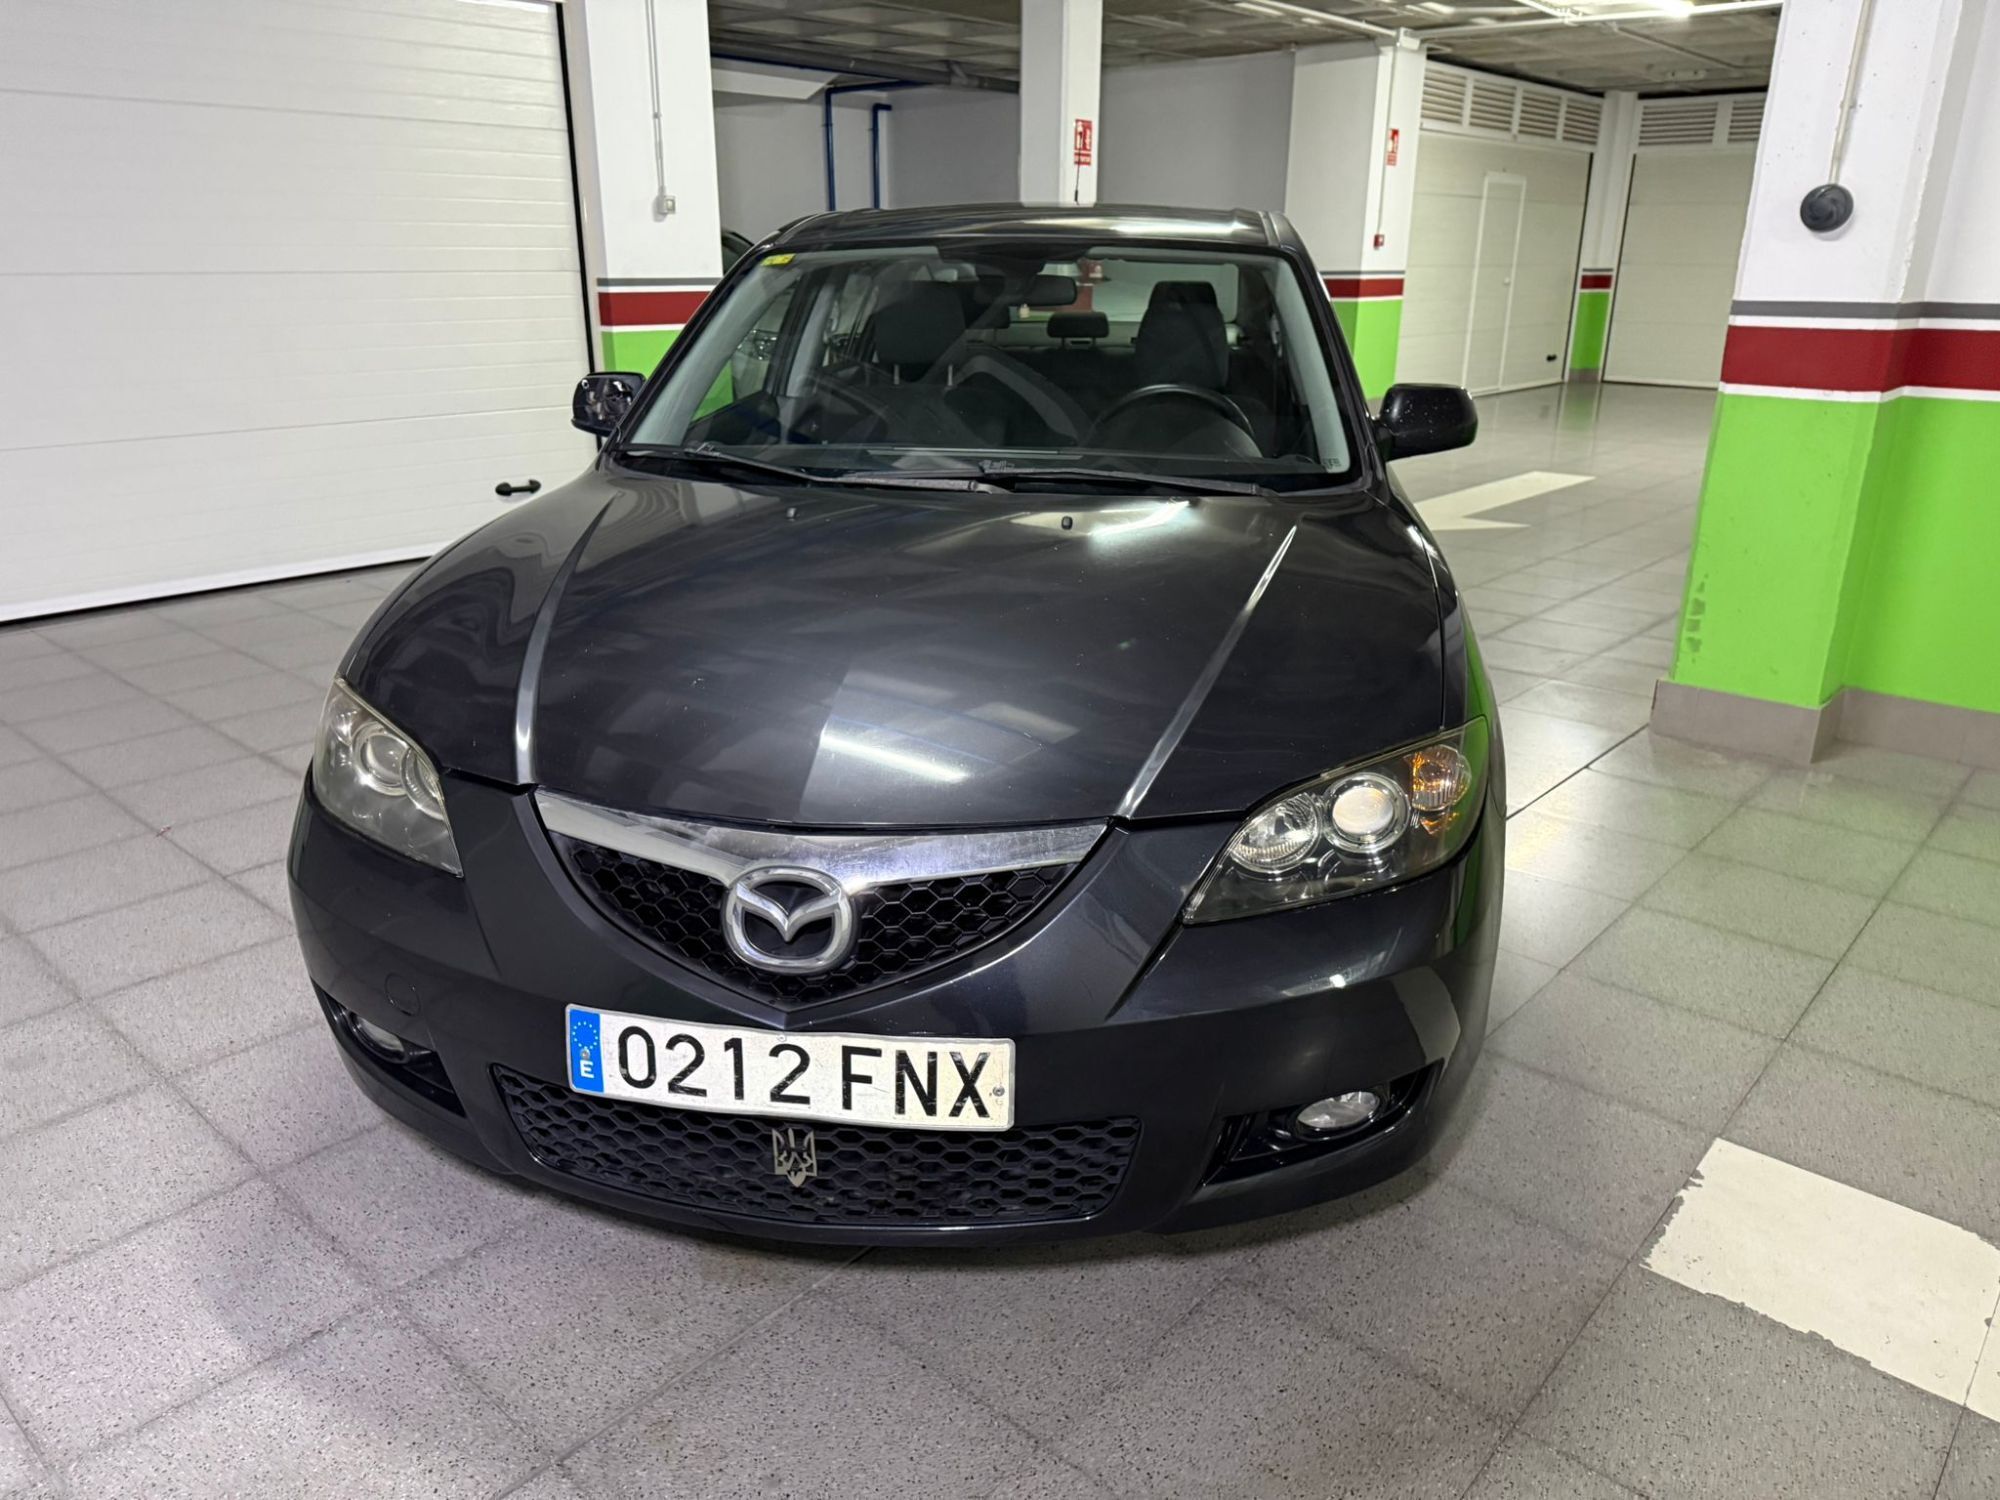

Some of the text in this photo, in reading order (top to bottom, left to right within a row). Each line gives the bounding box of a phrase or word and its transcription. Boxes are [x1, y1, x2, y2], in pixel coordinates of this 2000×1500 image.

[581, 1061, 594, 1078] E
[618, 1026, 989, 1118] 0212 FNX
